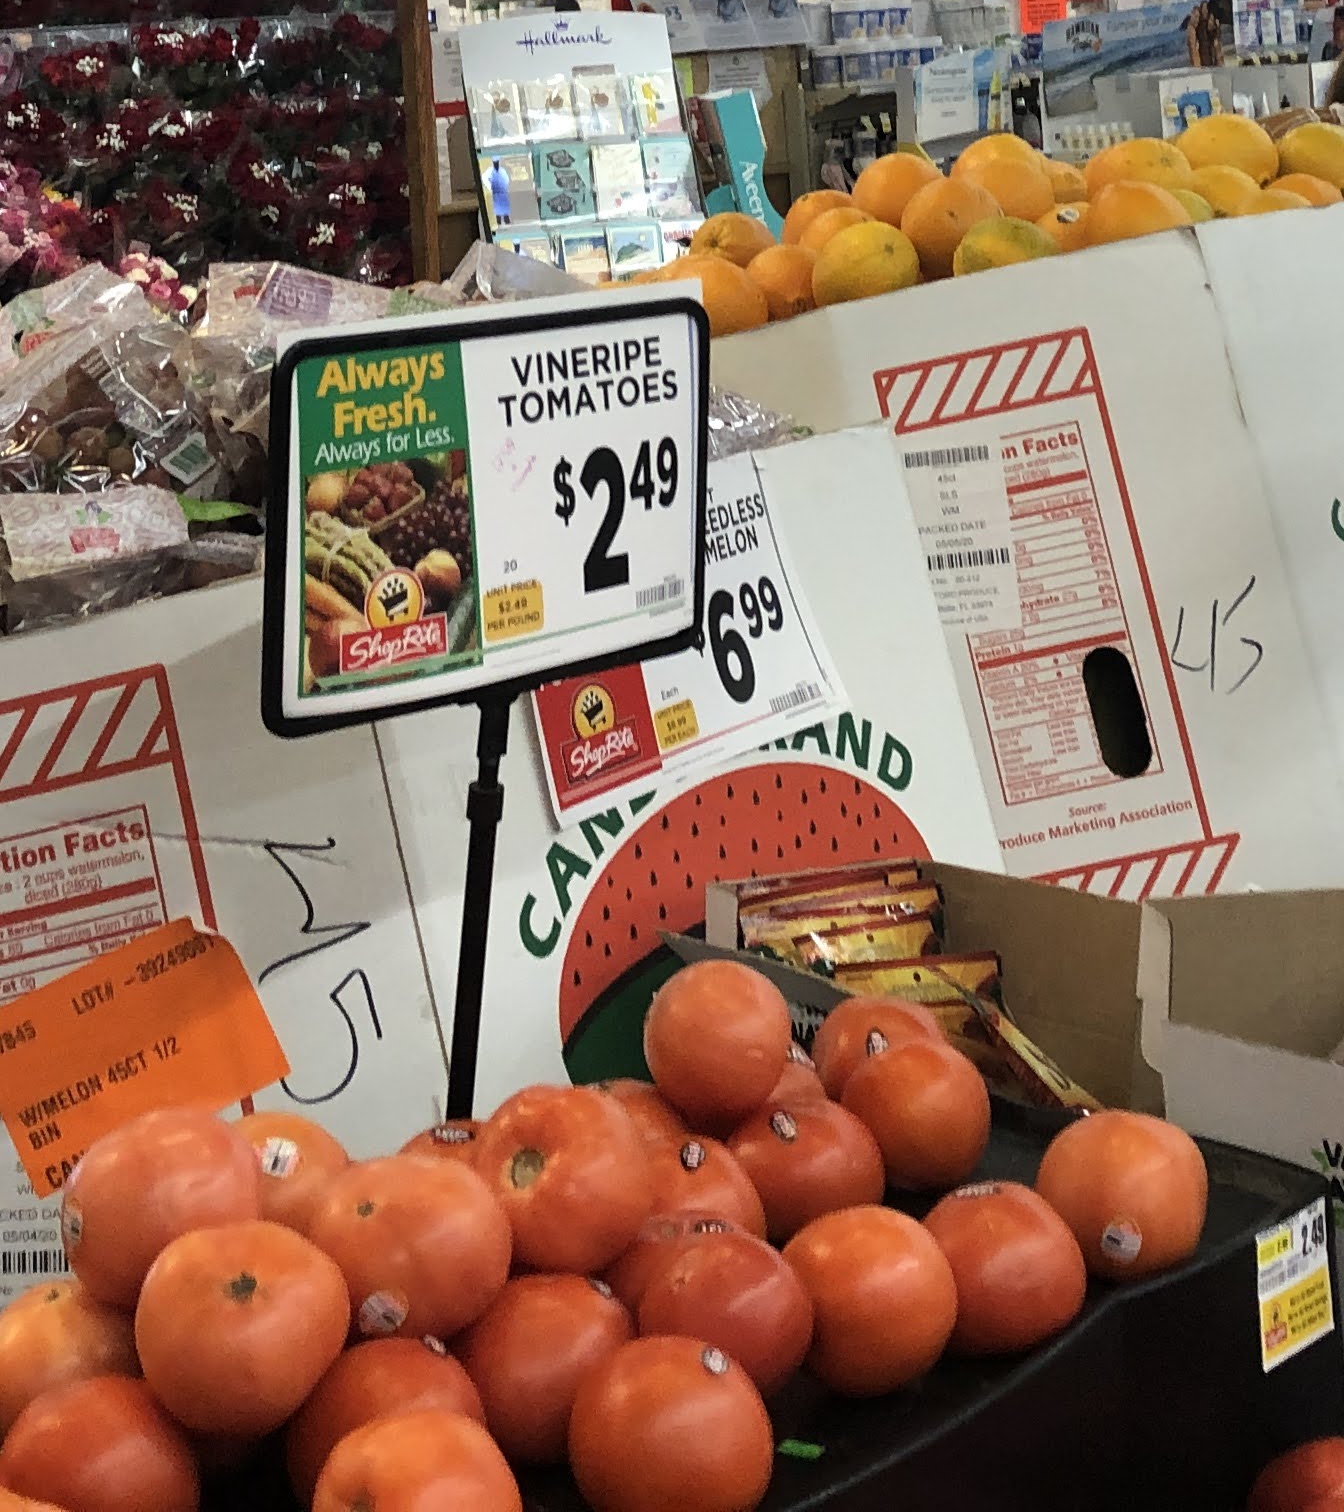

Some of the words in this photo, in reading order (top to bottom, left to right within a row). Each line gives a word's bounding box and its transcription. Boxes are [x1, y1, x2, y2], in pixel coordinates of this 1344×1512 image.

[516, 25, 613, 56] Hallmark
[317, 352, 445, 398] Always
[511, 336, 661, 386] VINERIPE
[333, 391, 437, 439] Fresh.
[498, 370, 678, 428] TOMATOES
[314, 436, 381, 467] Always
[386, 431, 411, 453] for
[415, 424, 456, 449] Less.
[1022, 431, 1079, 456] Facts
[706, 493, 764, 534] EDLESS
[918, 522, 959, 535] PACKED
[960, 519, 987, 531] DATE
[347, 619, 444, 672] ShopRite
[975, 646, 1011, 660] Protein
[661, 686, 680, 702] Each
[569, 727, 638, 779] ShopRite
[1047, 815, 1117, 841] Marketing
[1119, 798, 1193, 825] Association
[1068, 801, 1107, 819] Source:
[62, 821, 146, 858] Facts
[22, 875, 32, 888] 2
[35, 870, 65, 888] cups
[67, 849, 146, 876] watermelon,
[519, 788, 658, 961] CAN
[24, 887, 59, 905] diced
[7, 920, 47, 938] Serving
[17, 1076, 104, 1128] W/MELON
[106, 1048, 149, 1086] 45CT
[152, 1036, 181, 1061] 1/2
[27, 1123, 62, 1151] BIN
[1301, 1213, 1325, 1257] 2.49
